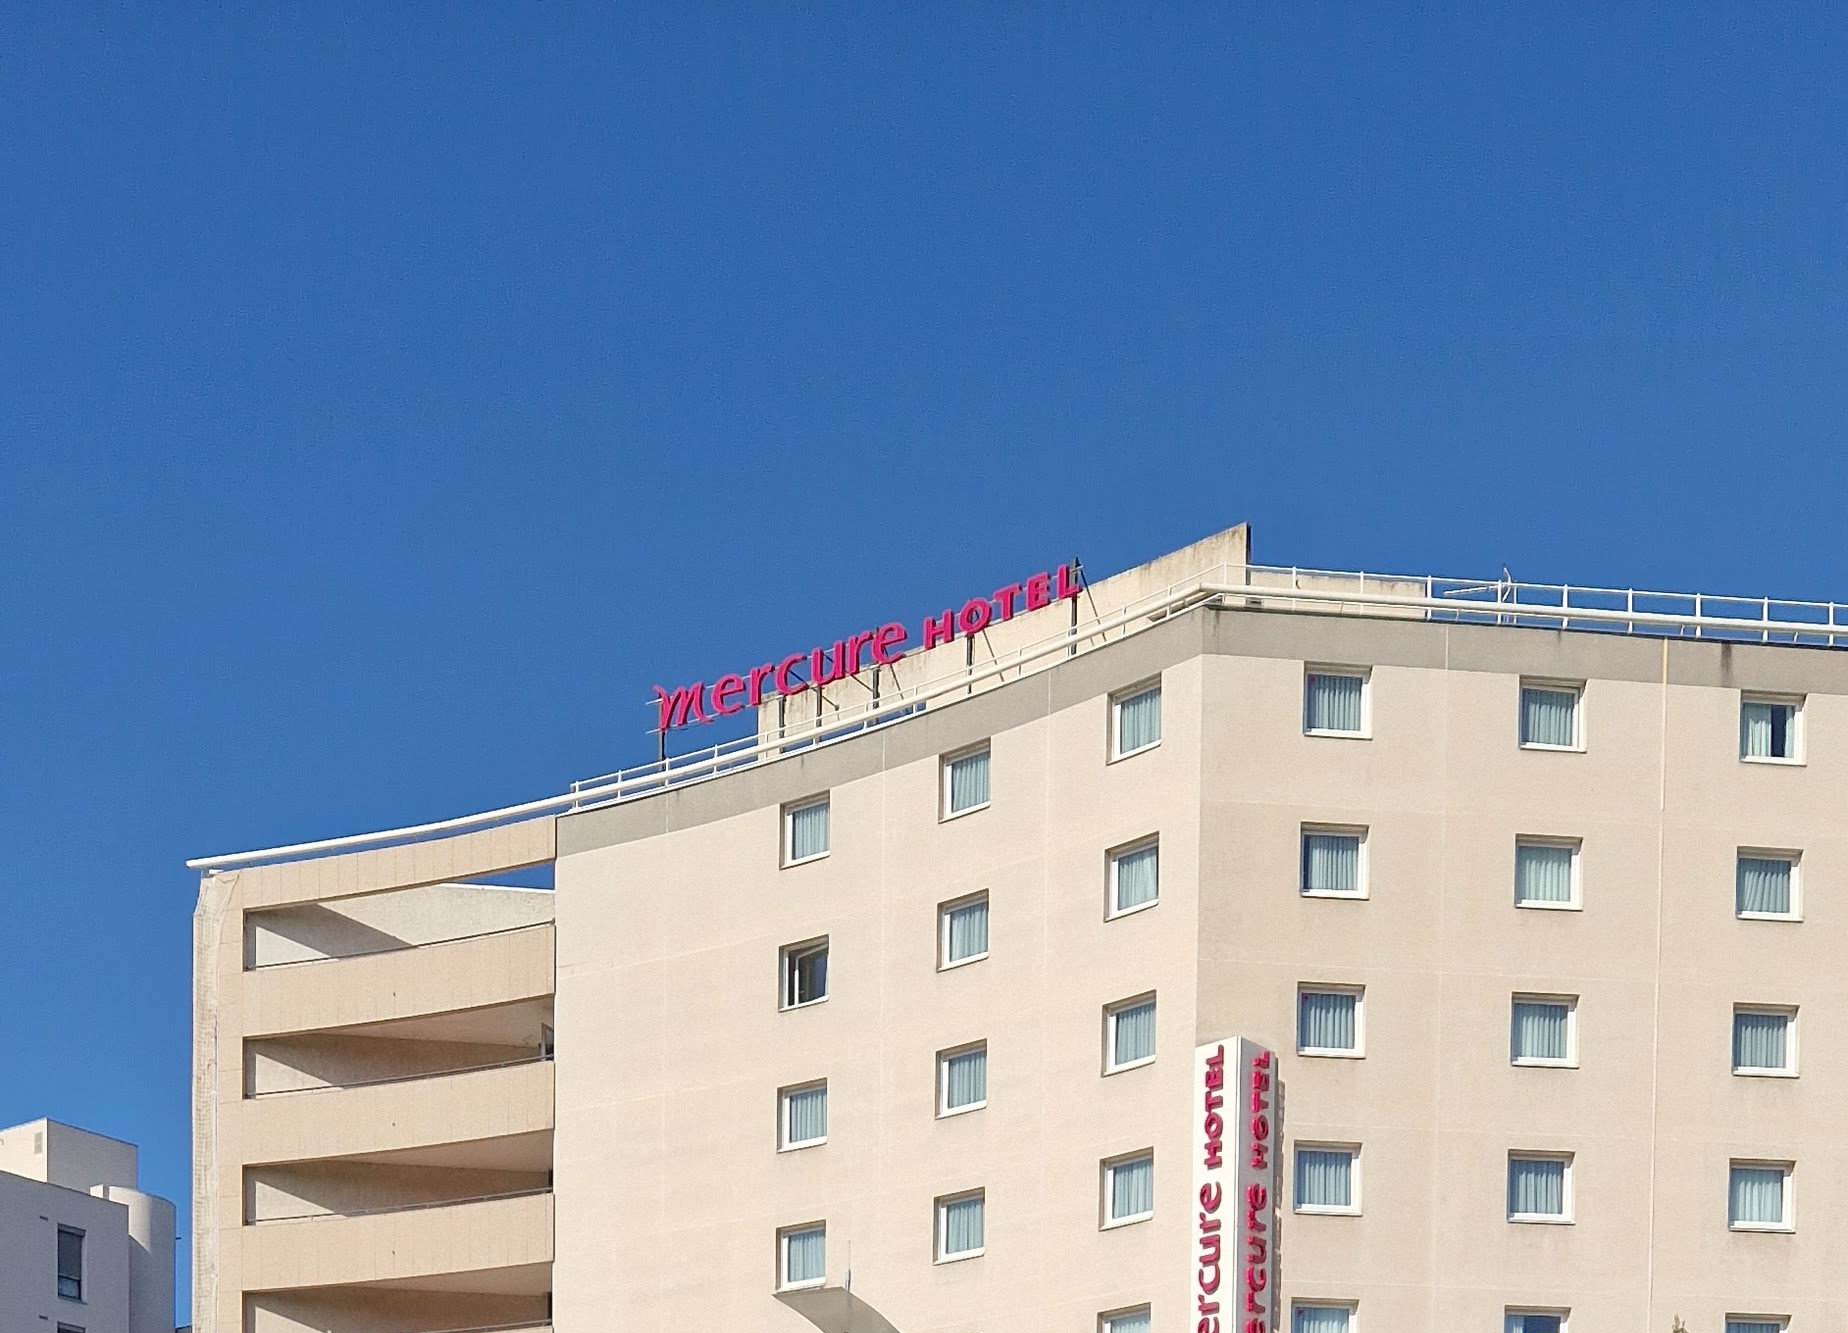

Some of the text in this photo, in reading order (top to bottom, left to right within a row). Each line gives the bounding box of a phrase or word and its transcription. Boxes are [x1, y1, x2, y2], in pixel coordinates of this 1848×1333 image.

[922, 562, 1084, 651] HOTEL
[1203, 1044, 1225, 1171] HOTEL
[1250, 1050, 1271, 1170] HOTEL
